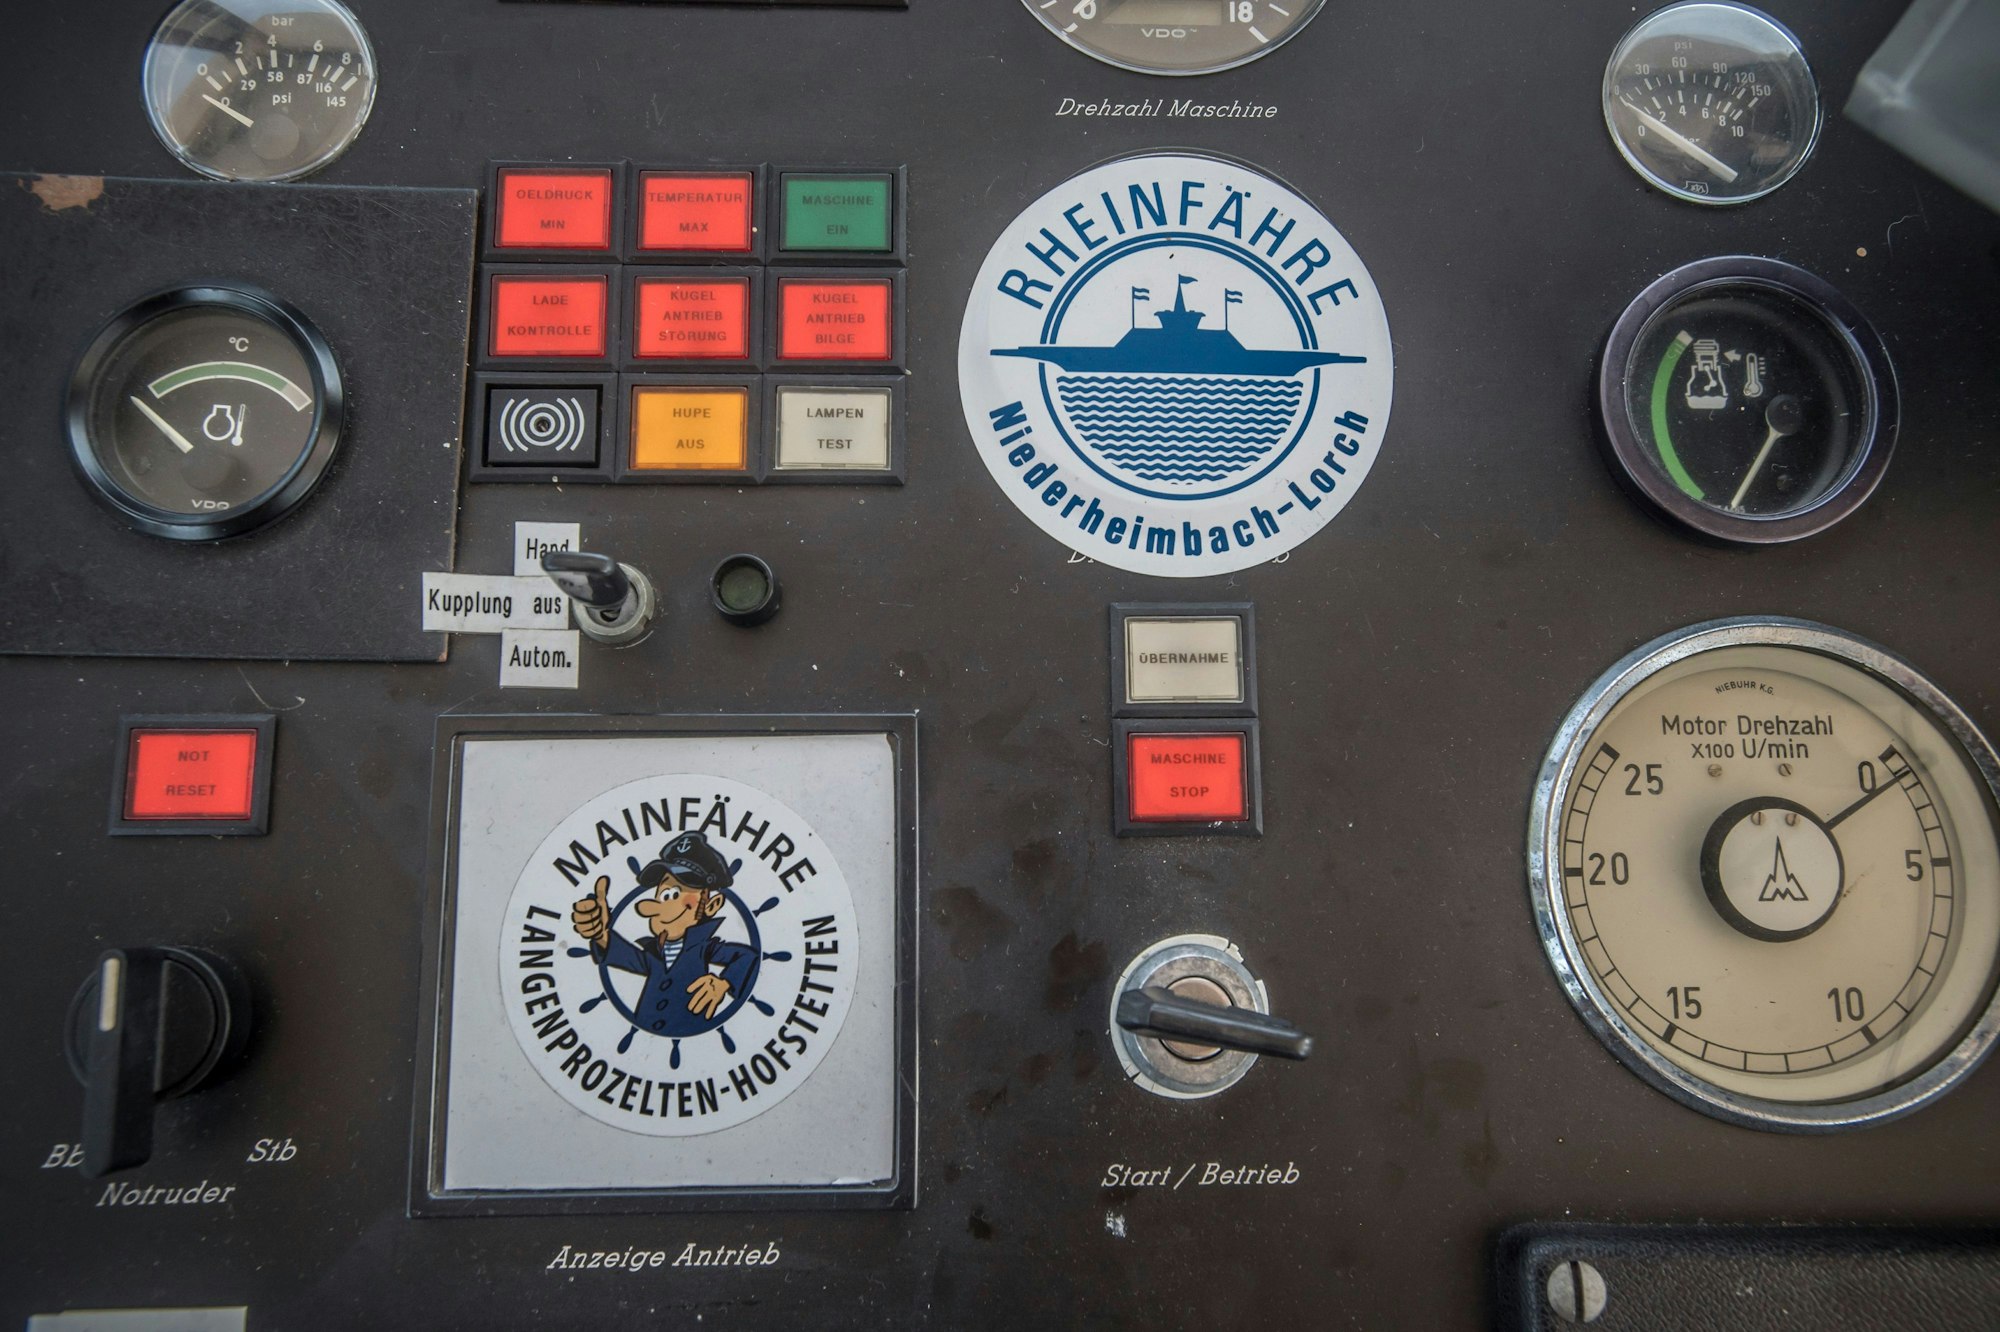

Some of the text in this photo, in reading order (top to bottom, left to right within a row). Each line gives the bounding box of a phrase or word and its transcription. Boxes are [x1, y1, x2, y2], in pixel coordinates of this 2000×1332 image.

[1229, 1, 1254, 23] 18
[271, 15, 295, 26] bar
[1141, 28, 1186, 38] VDO
[267, 35, 277, 47] 4
[313, 40, 324, 52] 6
[1674, 40, 1693, 51] psi
[235, 42, 243, 54] 2
[341, 52, 351, 65] 8
[1671, 57, 1688, 68] 60
[197, 64, 208, 76] 0
[1635, 64, 1650, 75] 30
[1712, 63, 1728, 74] 90
[267, 72, 284, 82] 58
[296, 74, 313, 84] 87
[1734, 72, 1756, 83] 120
[240, 79, 257, 91] 29
[315, 81, 333, 93] 116
[1750, 86, 1771, 97] 150
[272, 93, 292, 104] psi
[326, 96, 347, 107] 145
[1055, 98, 1278, 119] Drehzahl Maschine
[1678, 106, 1687, 116] 4
[1701, 108, 1709, 119] 6
[1659, 111, 1667, 123] 2
[1718, 115, 1727, 126] 8
[1637, 125, 1646, 137] 0
[1731, 126, 1744, 137] 10
[516, 188, 594, 201] OELDRUCK
[648, 192, 744, 204] TEMPERATUR
[802, 194, 874, 206] MASCHINE
[540, 219, 566, 230] MIN
[679, 221, 710, 233] MAX
[826, 224, 849, 235] EIN
[997, 180, 1360, 317] RHEINFÄHRE
[532, 294, 569, 306] LADE
[670, 290, 717, 302] KUGEL
[812, 293, 858, 304] KUGEL
[662, 310, 724, 322] ANTRIEB
[805, 312, 866, 324] ANTRIEB
[506, 325, 593, 337] KONTROLLE
[815, 333, 857, 345] BILGE
[672, 407, 712, 419] HUPE
[806, 407, 865, 419] LAMPEN
[675, 438, 706, 450] AUS
[816, 438, 854, 450] TEST
[988, 400, 1370, 557] Niederheimbach-Lorch
[191, 499, 230, 511] VDO
[428, 588, 562, 618] Kupplung aus
[509, 644, 572, 668] Autom.
[1139, 653, 1229, 664] ÜBERNAHME
[1715, 681, 1757, 694] NIEBUHR
[1661, 715, 1834, 737] Motor Drehzahl
[1742, 738, 1810, 760] U/min
[178, 751, 209, 762] NOT
[1151, 754, 1226, 764] MASCHINE
[1624, 763, 1665, 796] 25
[1858, 761, 1877, 793] 0
[166, 785, 217, 796] RESET
[1170, 787, 1210, 798] STOP
[552, 794, 818, 894] MAINFÄHRE
[1588, 853, 1630, 886] 20
[1905, 850, 1924, 882] 5
[1667, 986, 1702, 1020] 15
[1828, 987, 1865, 1023] 10
[519, 905, 840, 1118] LANGENPROZELTEN-HOFSTETTEN
[246, 1138, 298, 1163] Stb
[1100, 1163, 1172, 1187] Start
[1198, 1161, 1301, 1186] Betrieb
[95, 1180, 236, 1208] Notruder
[546, 1241, 781, 1272] Anzeige Antrieb
